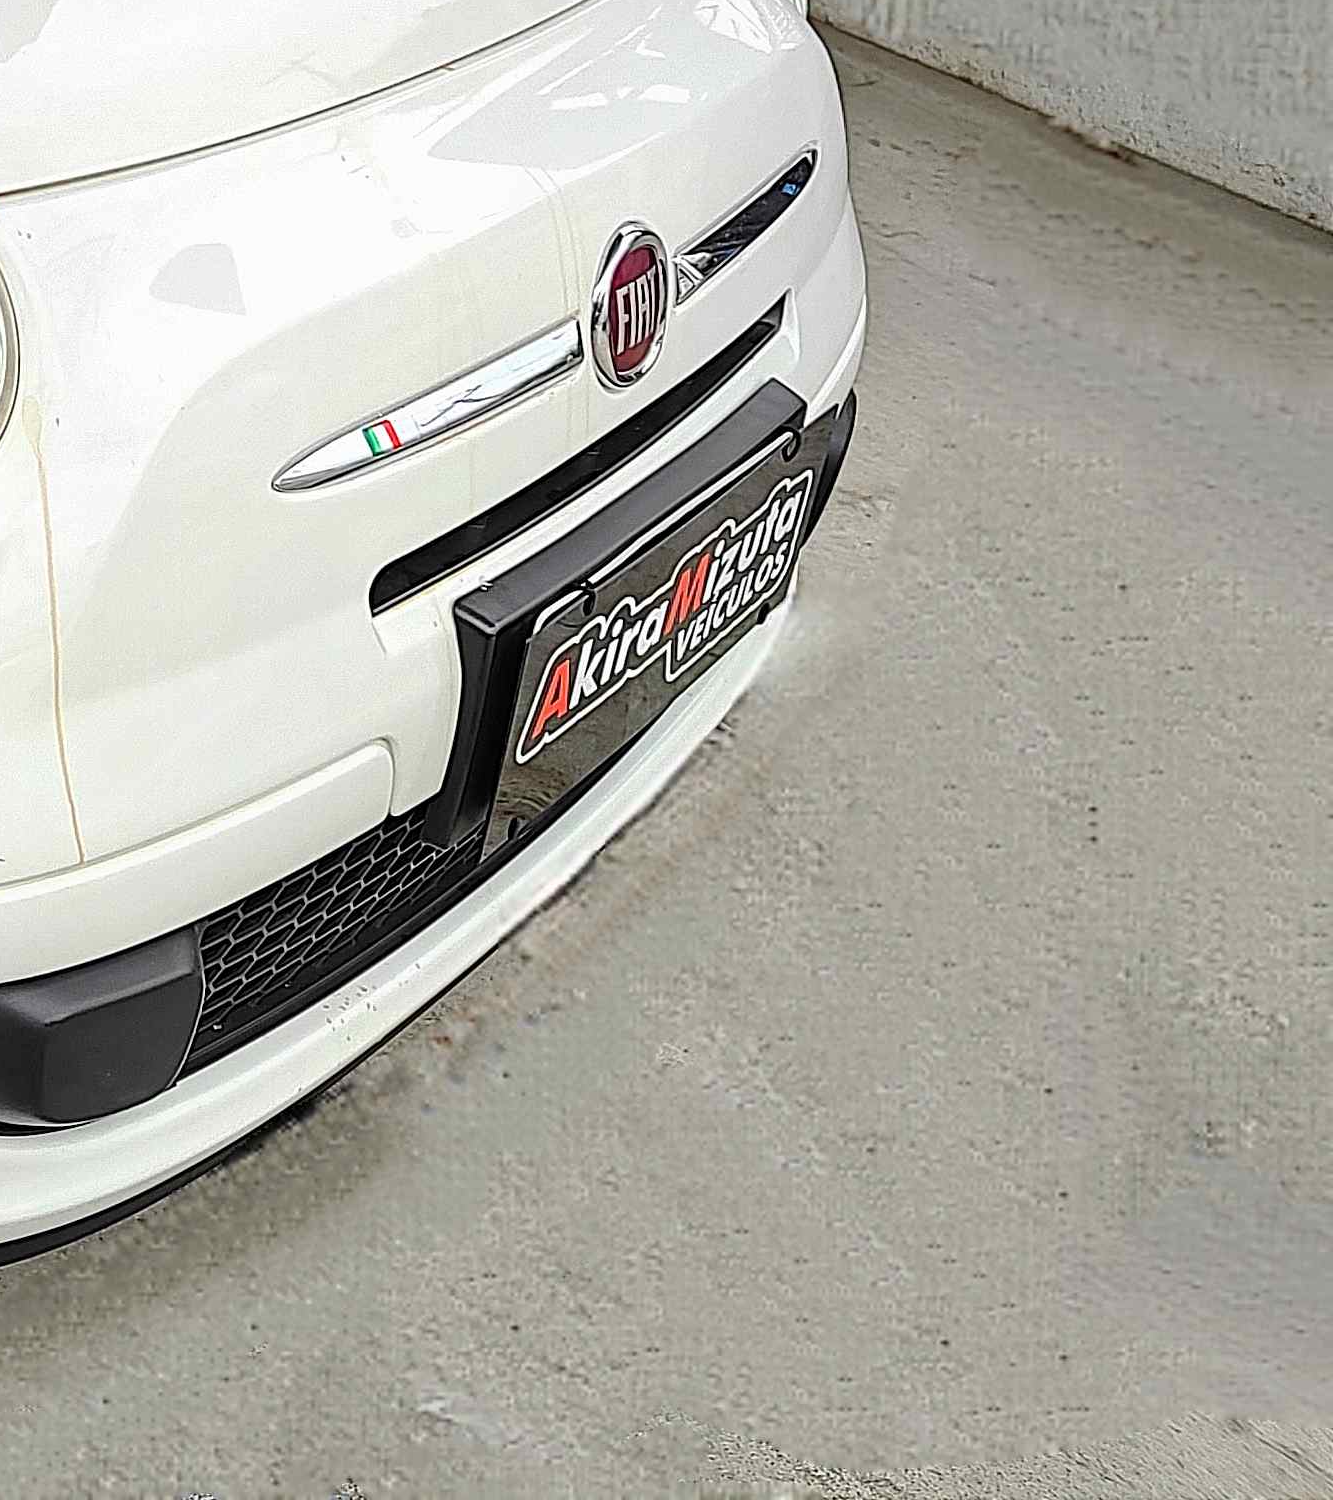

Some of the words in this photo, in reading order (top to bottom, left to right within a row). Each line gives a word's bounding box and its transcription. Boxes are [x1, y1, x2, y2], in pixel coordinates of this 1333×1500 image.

[614, 263, 657, 356] FIAT
[532, 490, 803, 741] AkiraMizuta
[676, 541, 789, 661] VEÍCULOS
